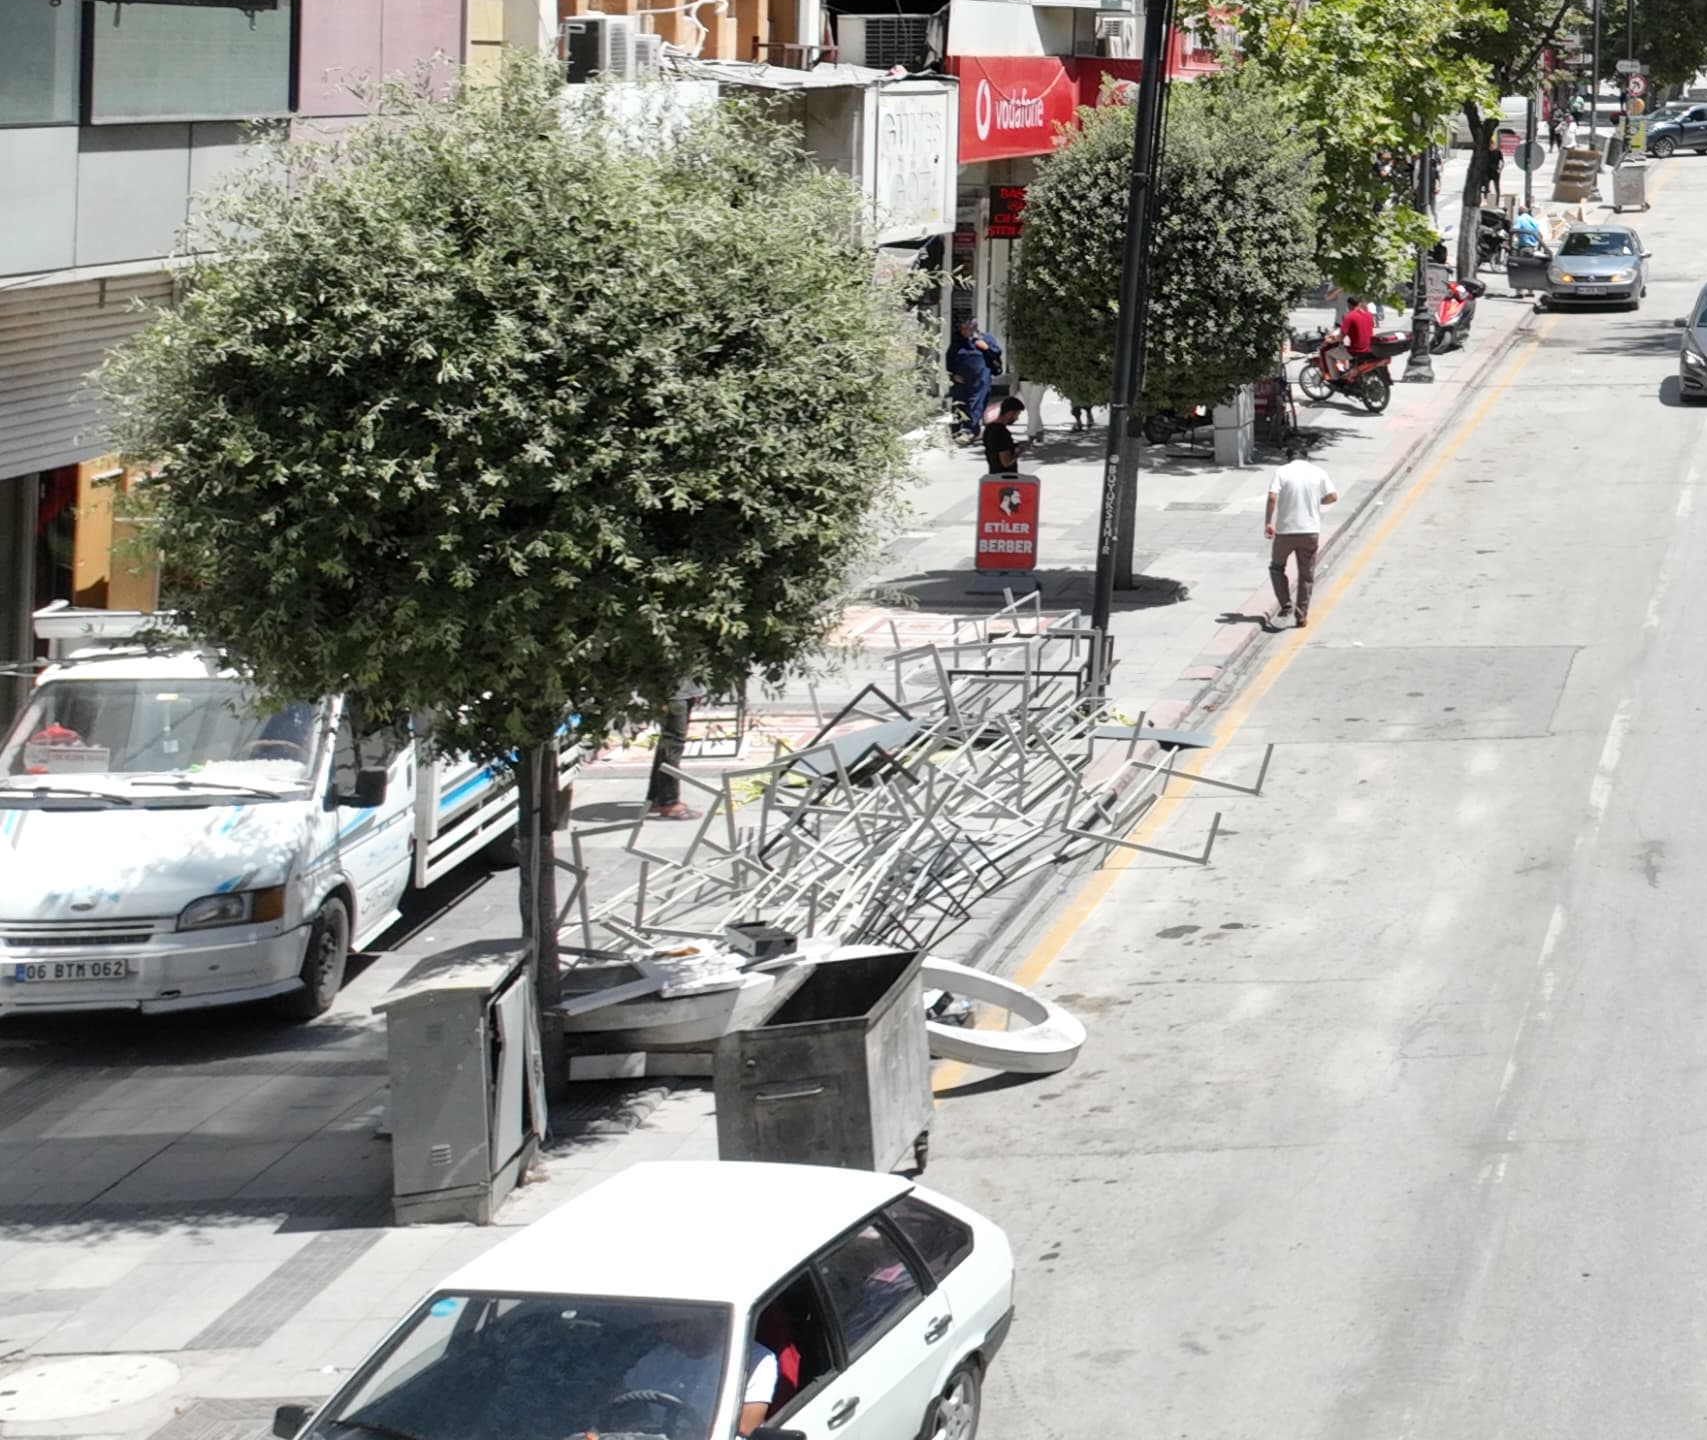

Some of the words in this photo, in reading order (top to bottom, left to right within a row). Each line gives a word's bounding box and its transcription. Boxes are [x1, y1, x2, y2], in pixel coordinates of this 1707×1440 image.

[996, 88, 1044, 130] vodafone
[983, 519, 1031, 534] ETİLER
[979, 539, 1033, 554] BERBER
[26, 962, 46, 980] 06
[55, 961, 87, 980] BTM
[90, 960, 124, 978] 062
